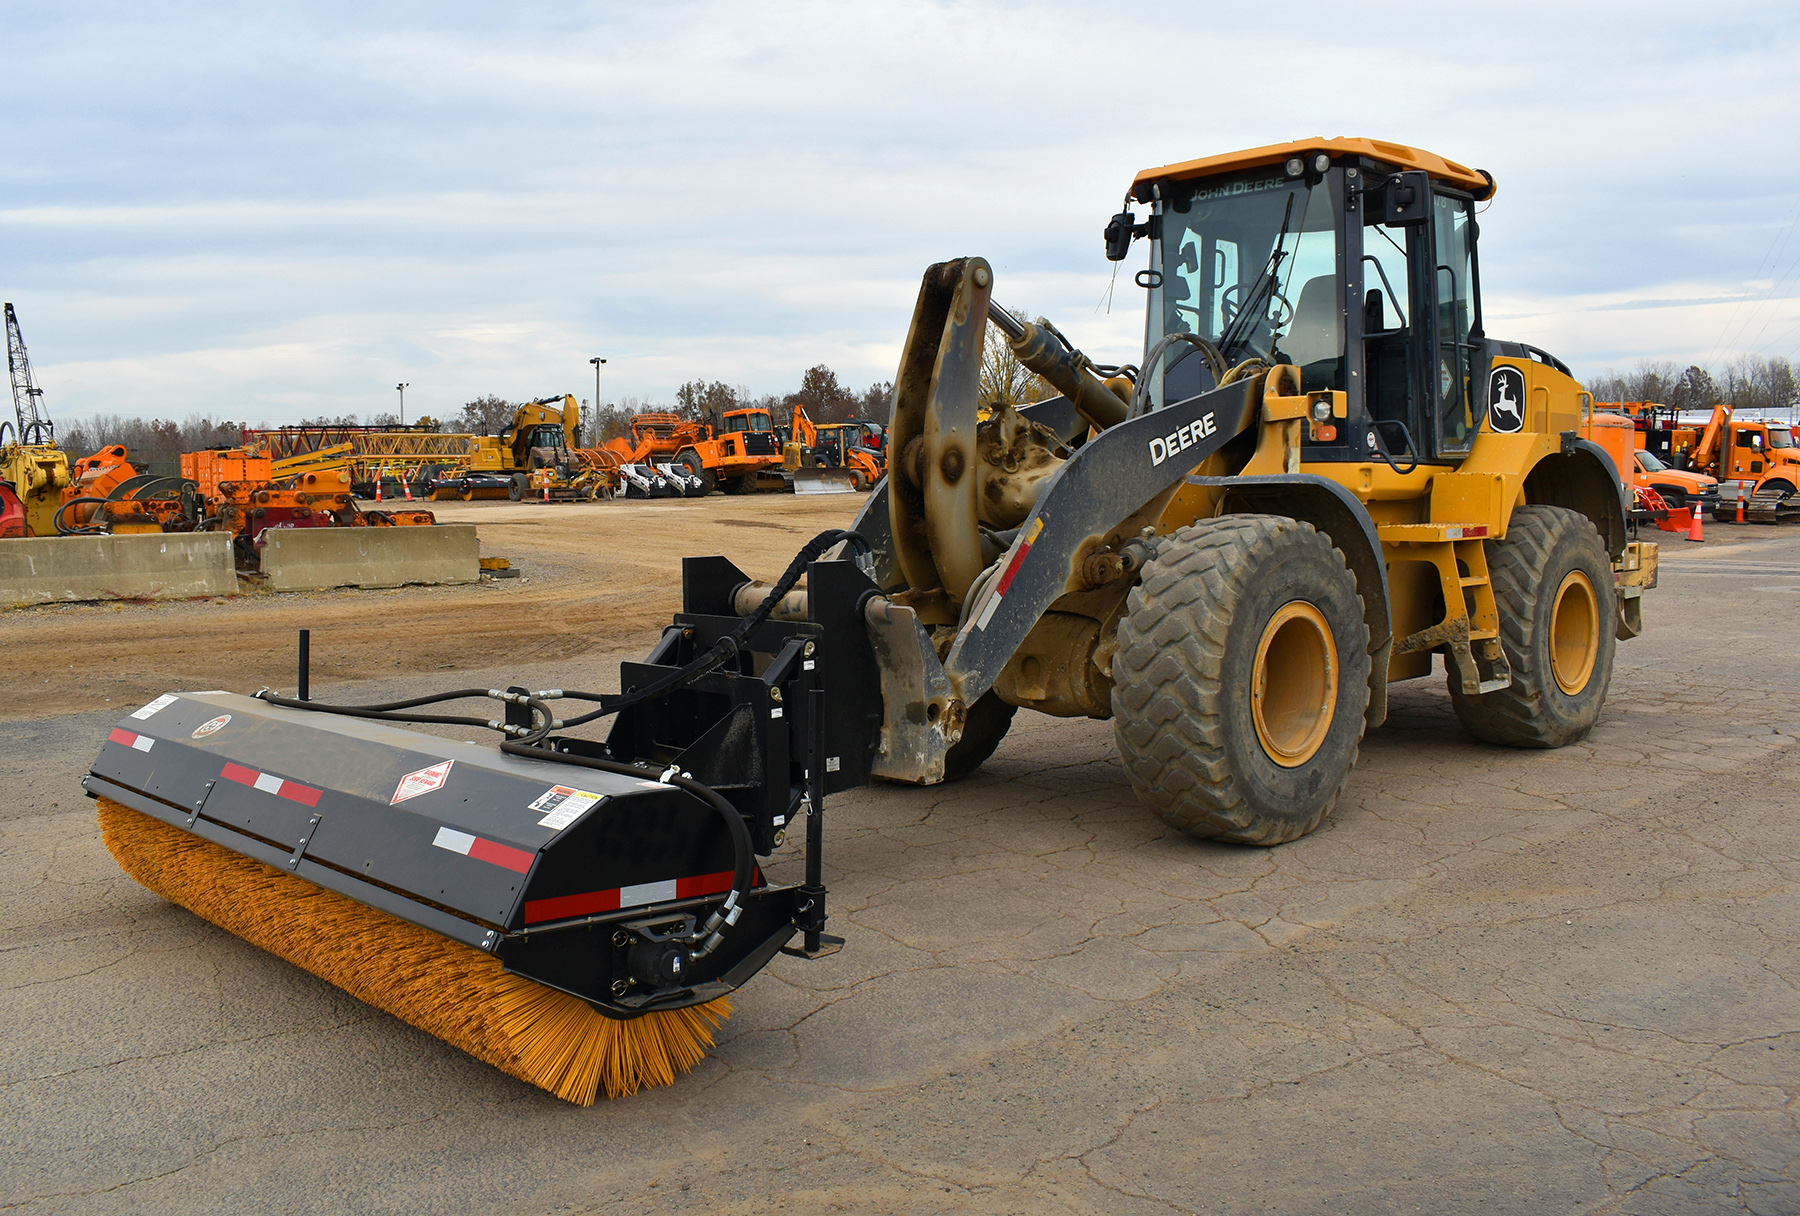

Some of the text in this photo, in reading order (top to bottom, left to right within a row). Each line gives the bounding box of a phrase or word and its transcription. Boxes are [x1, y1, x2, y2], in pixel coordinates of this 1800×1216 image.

[1189, 177, 1285, 202] JOHN DEERE
[1148, 411, 1217, 467] DEERE
